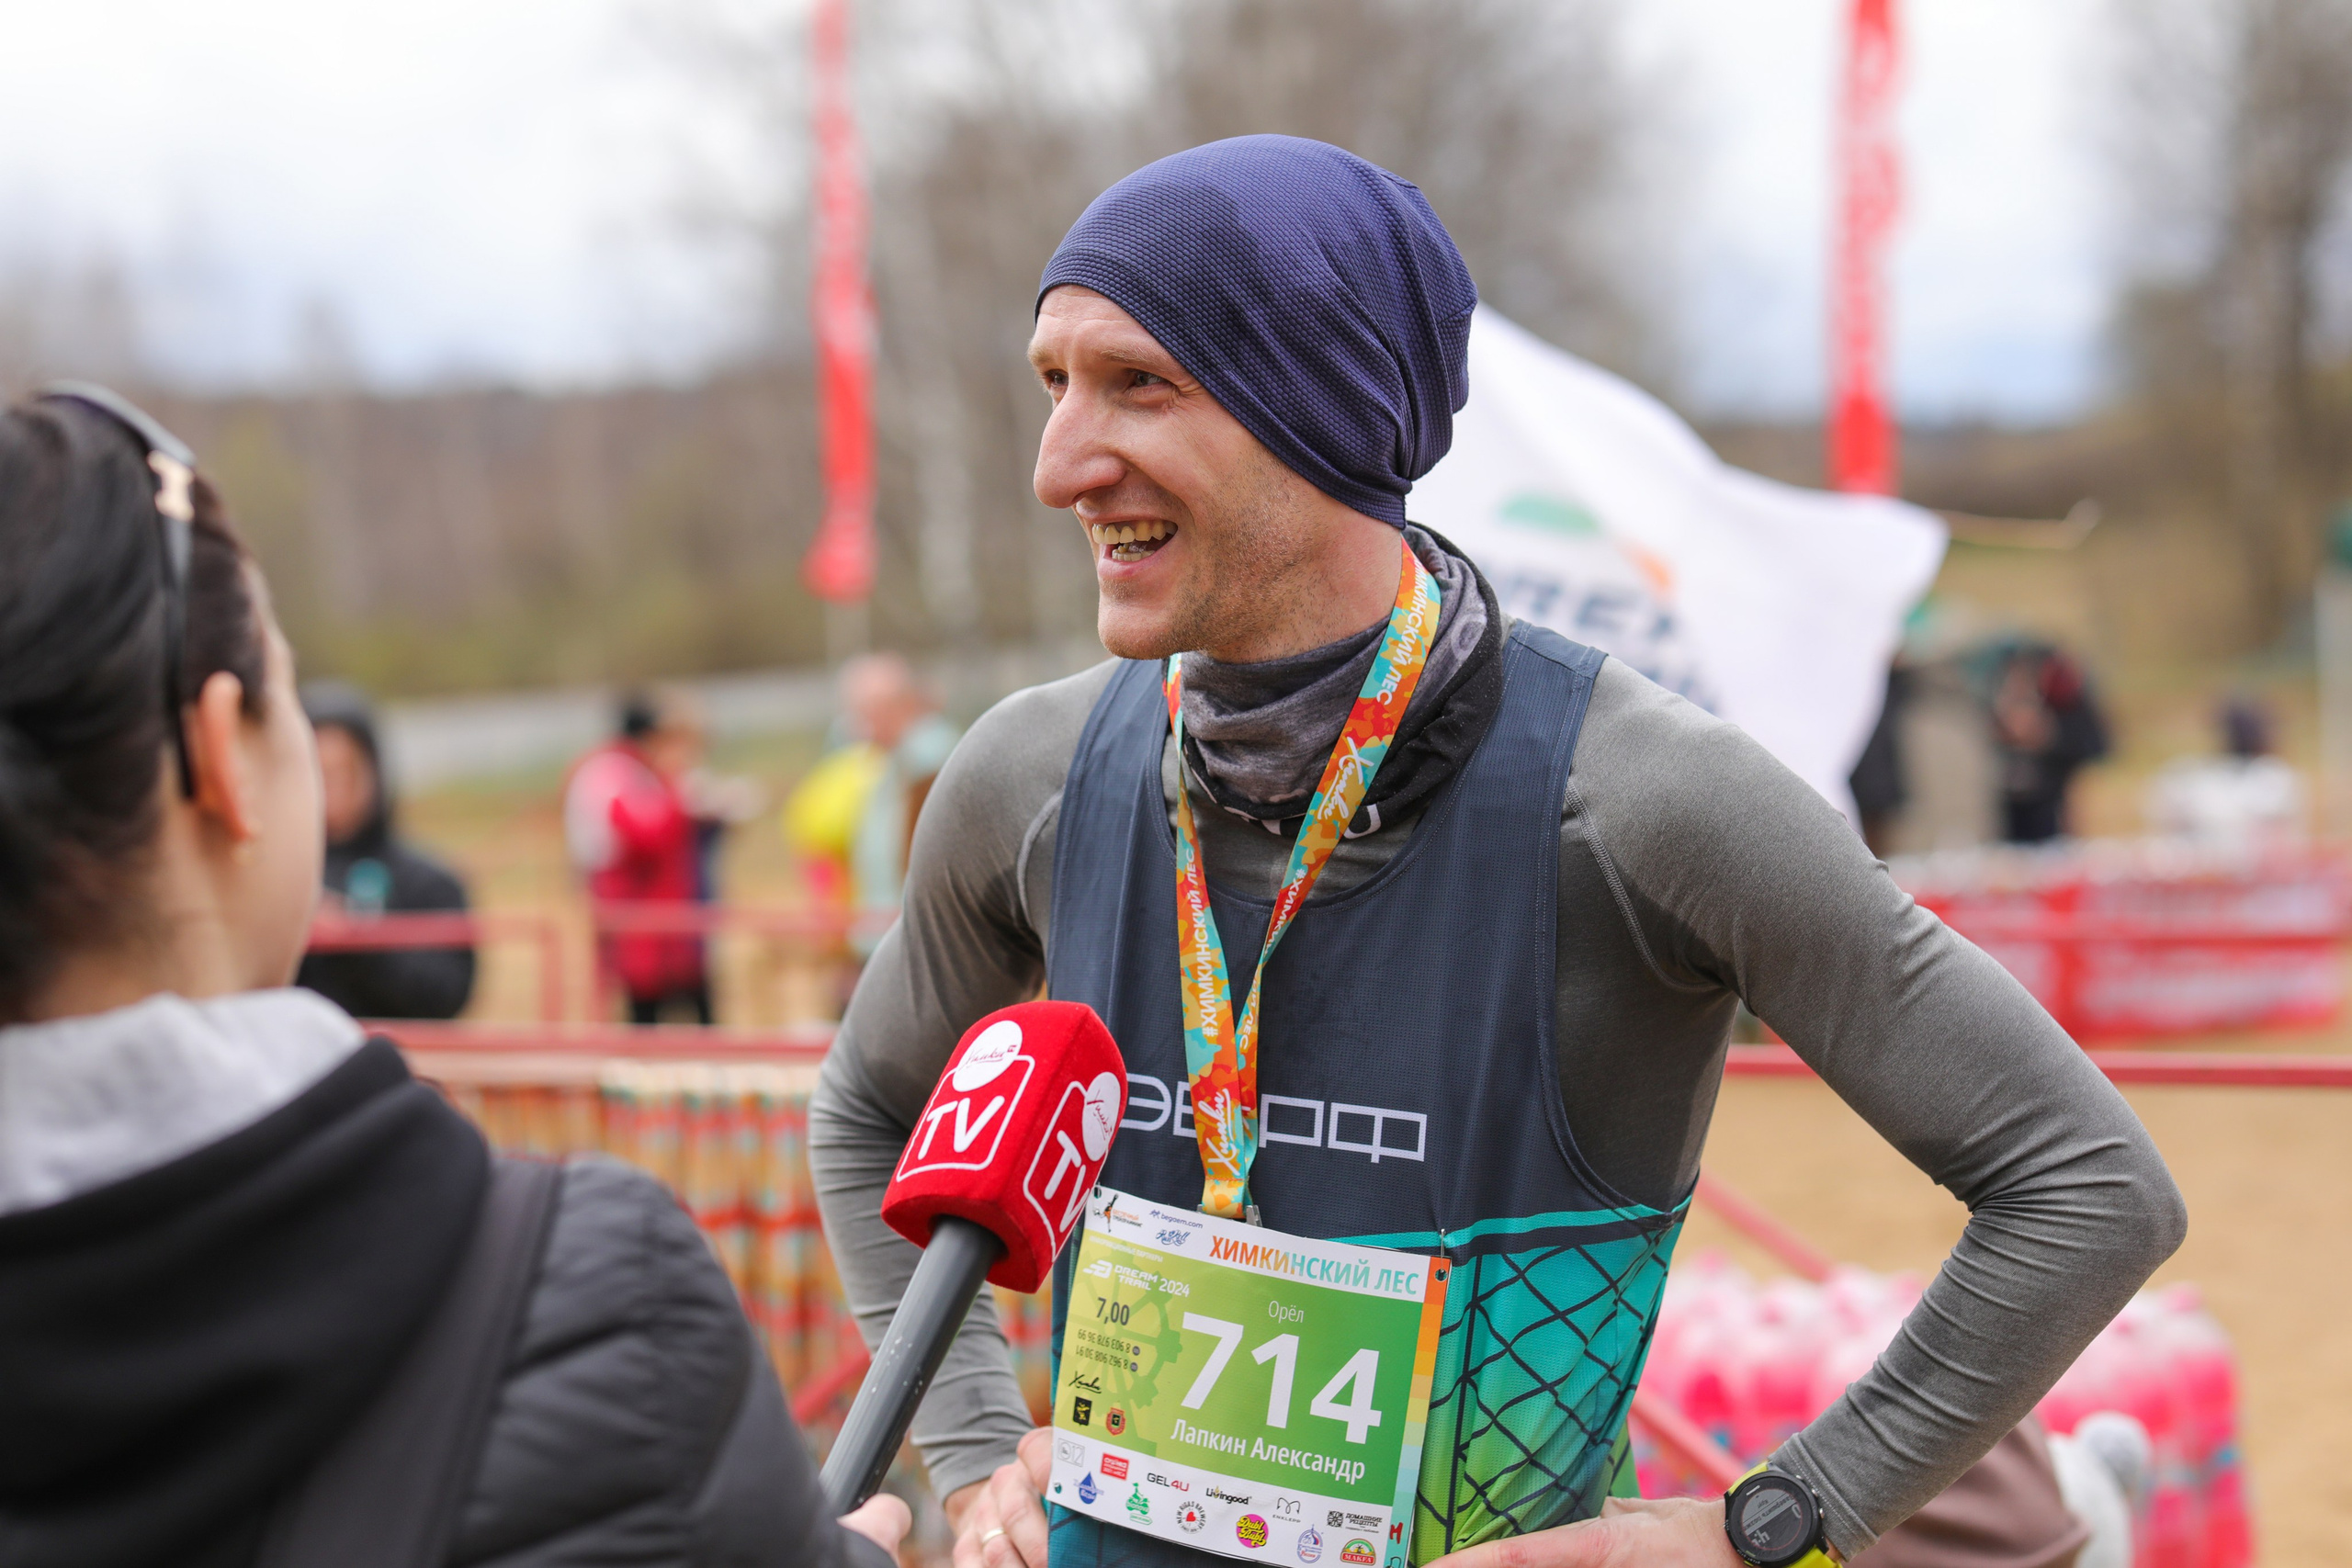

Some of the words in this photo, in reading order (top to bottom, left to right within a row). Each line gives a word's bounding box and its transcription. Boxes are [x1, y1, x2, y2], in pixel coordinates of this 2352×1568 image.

[1376, 670, 1402, 705] ЛЕС
[1185, 847, 1200, 888] ЛЕС
[1187, 890, 1219, 1037] #ХИМКИНСКИЙ
[1239, 1011, 1254, 1050] ЛЕС
[918, 1095, 1005, 1160] TV
[1044, 1130, 1091, 1233] TV
[1114, 1264, 1159, 1283] DREAM
[1209, 1235, 1369, 1289] ХИМКИНСКИЙ
[1374, 1268, 1419, 1295] ЛЕС
[1117, 1274, 1152, 1291] TRAIL
[1159, 1278, 1191, 1298] 2024
[1096, 1296, 1130, 1325] 7,00
[1268, 1300, 1305, 1324] Орёл
[1181, 1311, 1382, 1445] 714
[1170, 1418, 1247, 1456] Лапкин
[1250, 1437, 1366, 1486] Александр
[1147, 1472, 1190, 1493] GEL4U
[1194, 1503, 1206, 1530] BREWERY
[1237, 1516, 1266, 1532] Dubl
[1238, 1527, 1267, 1548] Bubl
